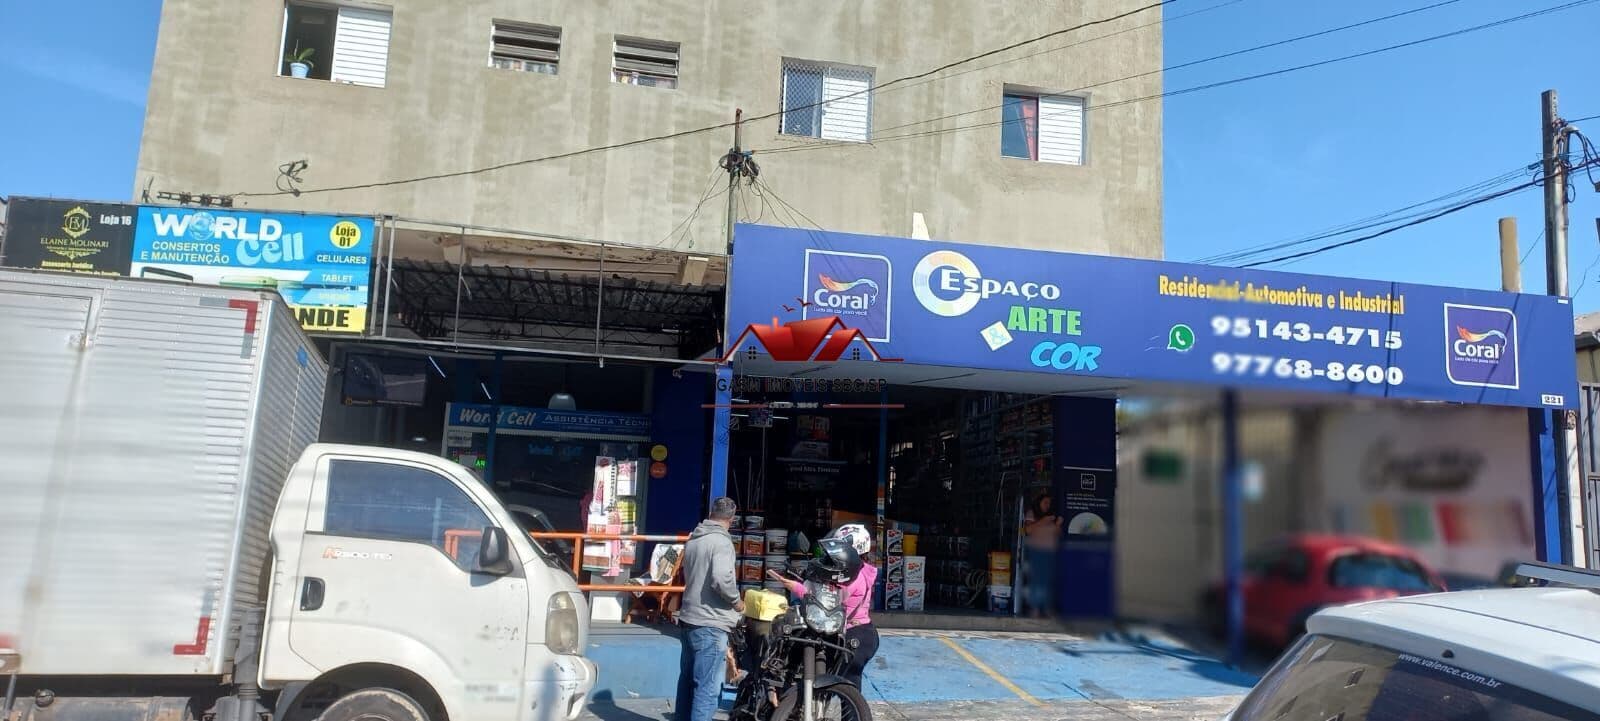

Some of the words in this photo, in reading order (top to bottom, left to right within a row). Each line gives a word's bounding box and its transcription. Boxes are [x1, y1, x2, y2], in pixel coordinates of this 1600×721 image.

[99, 214, 120, 226] Loja
[121, 215, 133, 226] 16
[334, 223, 357, 239] Loja
[40, 238, 69, 247] ELAINE
[70, 240, 109, 249] MOLINARI
[152, 241, 221, 253] CONSERTOS
[236, 231, 304, 266] Cell
[338, 236, 352, 248] 01
[140, 251, 148, 261] E
[150, 251, 230, 264] MANUTENÇÃO
[316, 253, 367, 265] CELULARES
[321, 273, 353, 283] TABLET
[813, 288, 869, 310] Coral
[1326, 296, 1336, 309] e
[1340, 290, 1405, 315] Industrial
[1007, 305, 1082, 336] ARTE
[1210, 316, 1403, 351] 95143-4715
[1030, 342, 1102, 372] COR
[1453, 339, 1500, 359] Coral
[1211, 352, 1404, 386] 97768-8600
[1543, 395, 1562, 405] 221
[507, 412, 537, 427] Cell
[1397, 652, 1503, 689] www.valence.com.br
